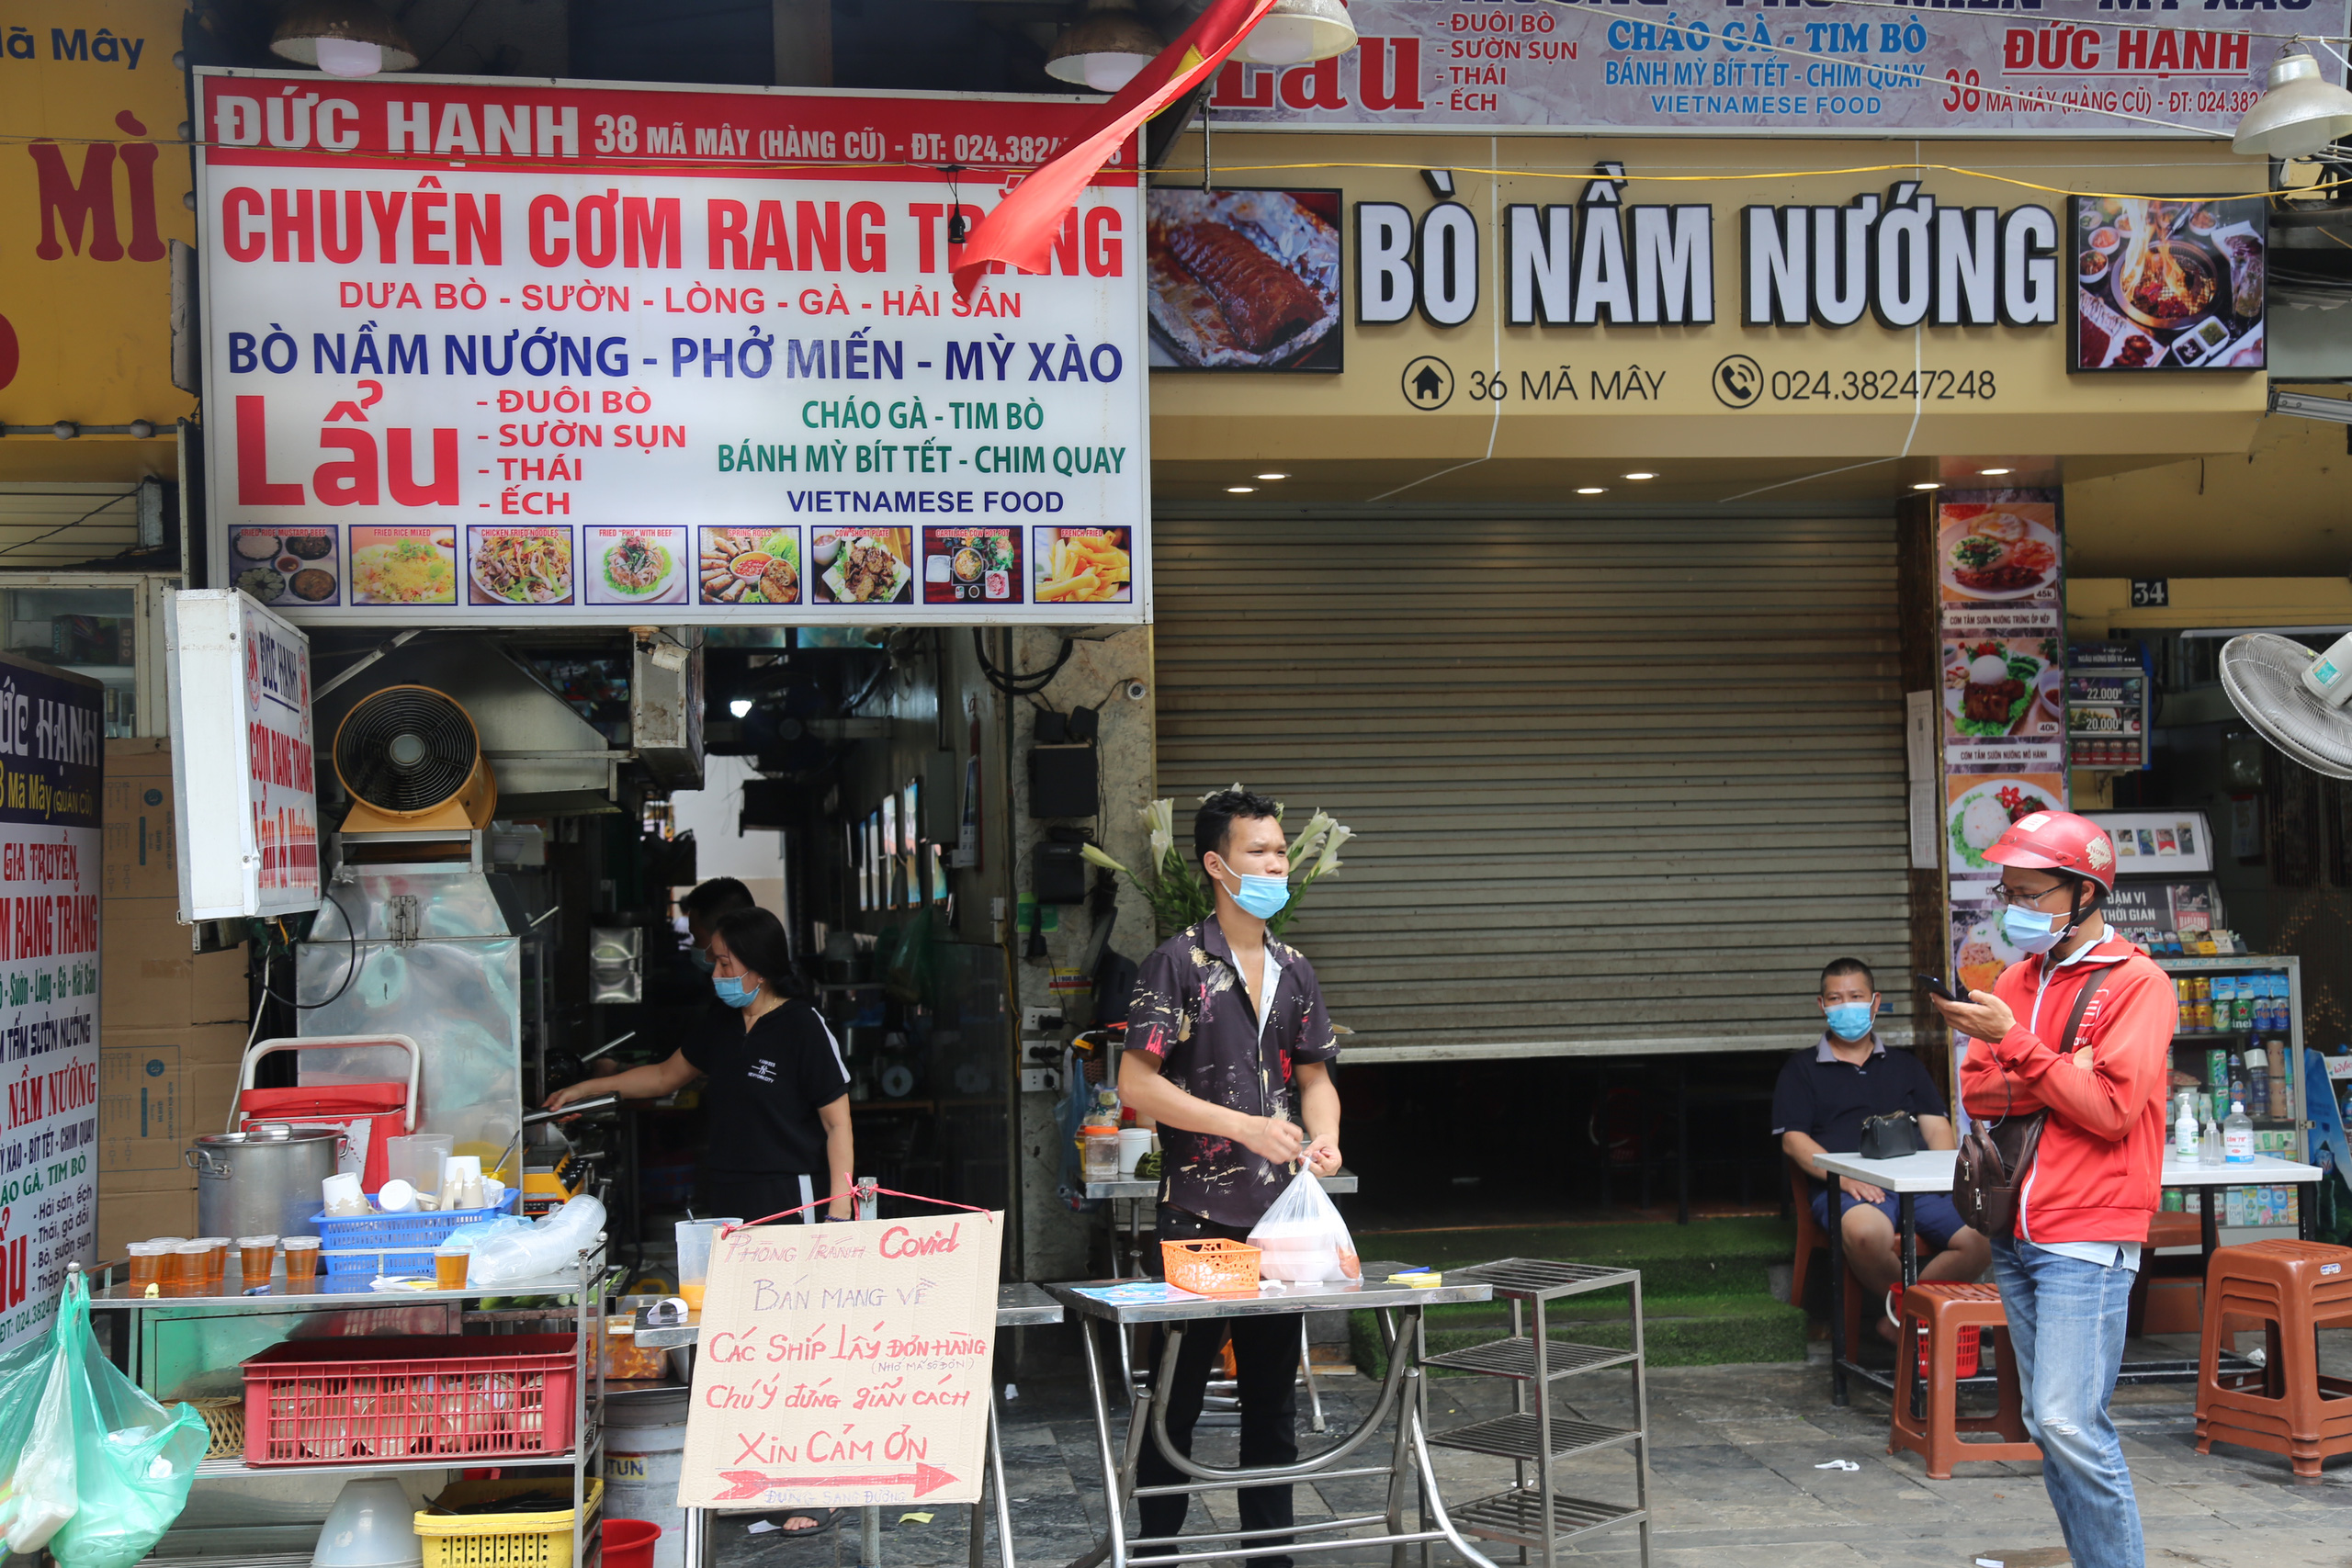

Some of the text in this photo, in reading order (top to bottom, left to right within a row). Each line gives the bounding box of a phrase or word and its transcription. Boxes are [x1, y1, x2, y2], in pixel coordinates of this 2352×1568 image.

[1451, 11, 1555, 33] ĐUÔI BÒ
[1607, 12, 1928, 53] CHÁO GÀ TIM BÒ
[51, 28, 145, 70] Mây
[1451, 37, 1577, 66] SƯỜN SỤN
[2003, 20, 2249, 78] ĐỨC HẠNH
[1450, 62, 1506, 85] THÁI
[1606, 55, 1926, 90] BÁNH MỲ BÍT TẾT CHIM QUAY
[1450, 87, 1498, 111] ẾCH
[1651, 96, 1882, 114] VIETNAMESE FOOD
[1942, 69, 1980, 113] 38
[1985, 85, 2192, 115] MÃ MÂY (HÀNG CŨ) ĐT:
[214, 86, 947, 167] ĐỨC HẠNH 38 MÃ MÂY (HÀNG CŨ) ĐT:
[28, 109, 166, 262] MÌ
[222, 175, 1123, 278] CHUYÊN CƠM RANG TRNG
[1355, 161, 2059, 331] BÒ NẦM NƯỚNG
[340, 276, 1022, 319] DƯA BÒ SƯỜN LÒNG GÀ HẢI SẢN
[229, 320, 1124, 384] BÒ NẦM NƯỚNG PHỞ MIẾN MỲ XÀO
[1469, 365, 1667, 401] 36 MÃ MÂY
[1772, 369, 1996, 401] 024.38247248
[497, 386, 651, 414] ĐUÔI BÒ
[802, 395, 1044, 430] CHÁO GÀ TIM BÒ
[235, 379, 459, 507] Lẩu
[499, 423, 686, 455] SƯỜN SỤN
[498, 453, 582, 481] THÁI
[718, 436, 1125, 477] BÁNH MỲ BÍT TẾT CHIM QUAY
[501, 484, 570, 515] ẾCH
[786, 491, 1064, 513] VIETNAMESE FOOD
[241, 528, 260, 536] FRIED
[261, 528, 277, 536] RICE
[278, 528, 309, 536] MUSTARD
[374, 528, 431, 536] FRIED RICE MIXED
[481, 528, 559, 537] CHICKEN FRIED NOODLES
[599, 528, 673, 536] FRIED WITH BEEF
[728, 529, 772, 537] SPRING ROLLS
[835, 529, 889, 537] COW SHORT PLATE
[935, 529, 1010, 537] CARTILAGE COW HOT POT
[1061, 529, 1102, 537] FRENCH FRIED
[2037, 590, 2052, 598] 45k
[2134, 581, 2165, 604] 34
[36, 698, 98, 776] HẠNH
[2041, 724, 2056, 732] 40k
[250, 719, 271, 783] CƠM
[271, 729, 292, 788] RANG
[8, 772, 26, 809] Mã
[28, 774, 52, 820] Mây
[4, 842, 26, 881] GIA
[16, 895, 52, 960] RANG
[2130, 908, 2155, 921] GIAN
[8, 1064, 43, 1130] NẦM
[48, 1056, 96, 1116] NƯỚNG
[879, 1223, 960, 1259] Covid
[753, 1273, 809, 1311] BÁN
[821, 1288, 888, 1308] MANG
